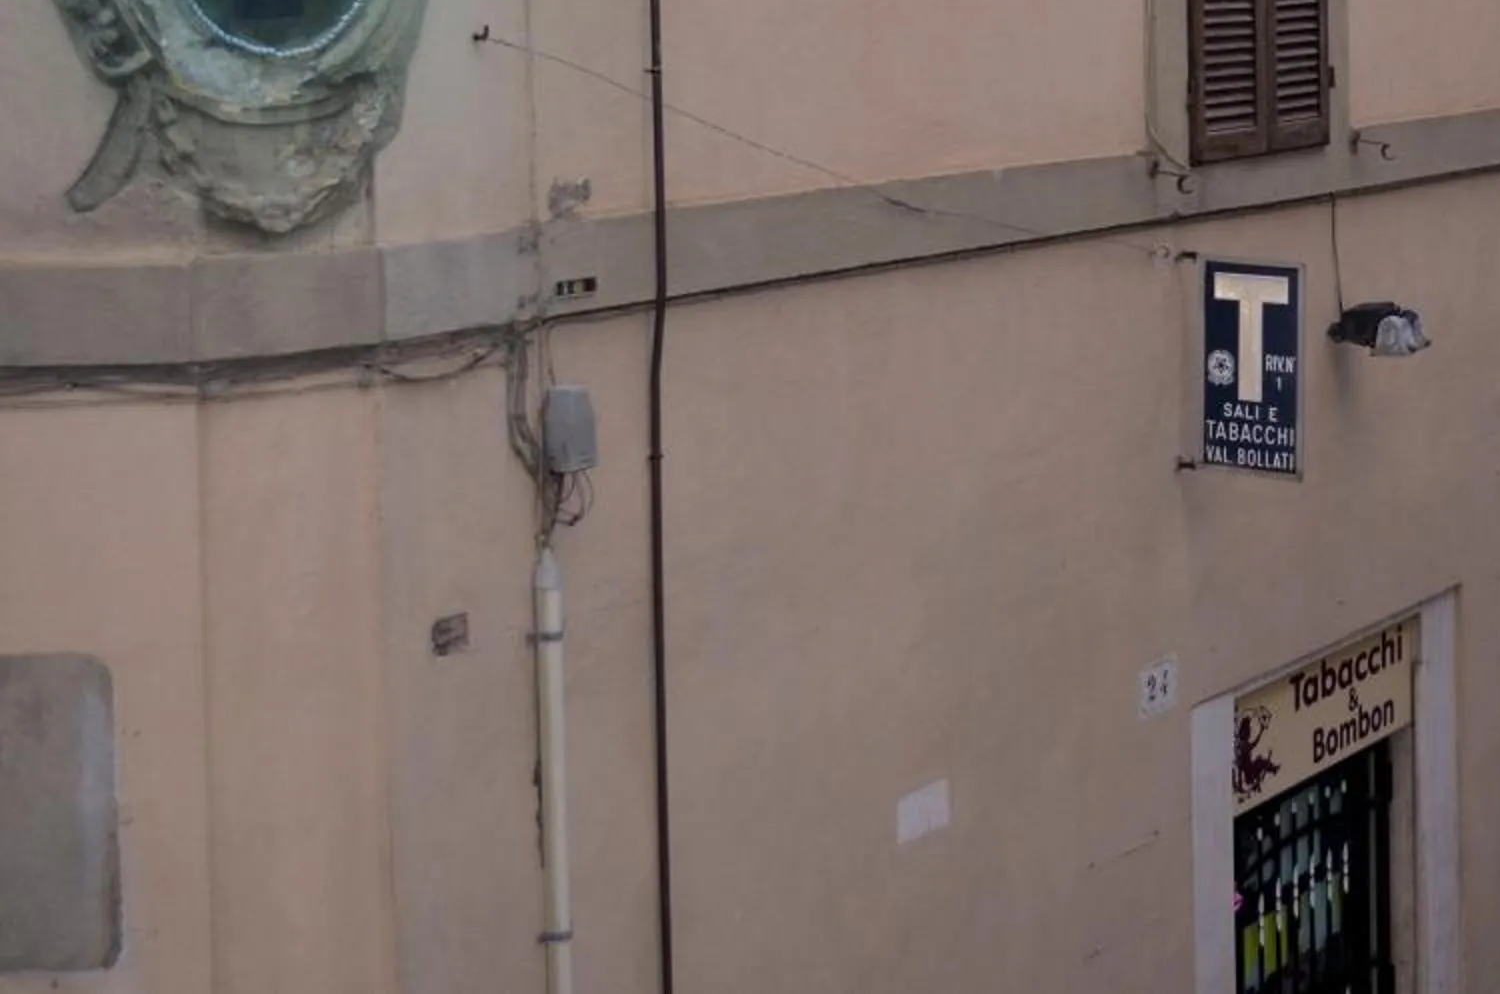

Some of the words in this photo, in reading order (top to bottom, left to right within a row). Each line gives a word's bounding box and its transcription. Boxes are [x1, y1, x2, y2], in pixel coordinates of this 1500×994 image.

[1213, 271, 1290, 403] T
[1275, 375, 1283, 393] 1
[1223, 402, 1260, 421] SALI
[1268, 406, 1279, 423] E
[1206, 419, 1295, 447] TABACCHI
[1237, 447, 1295, 471] BOLLATI
[1289, 623, 1404, 712] Tabacchi
[1347, 687, 1359, 712] &
[1312, 698, 1395, 763] Bombon
